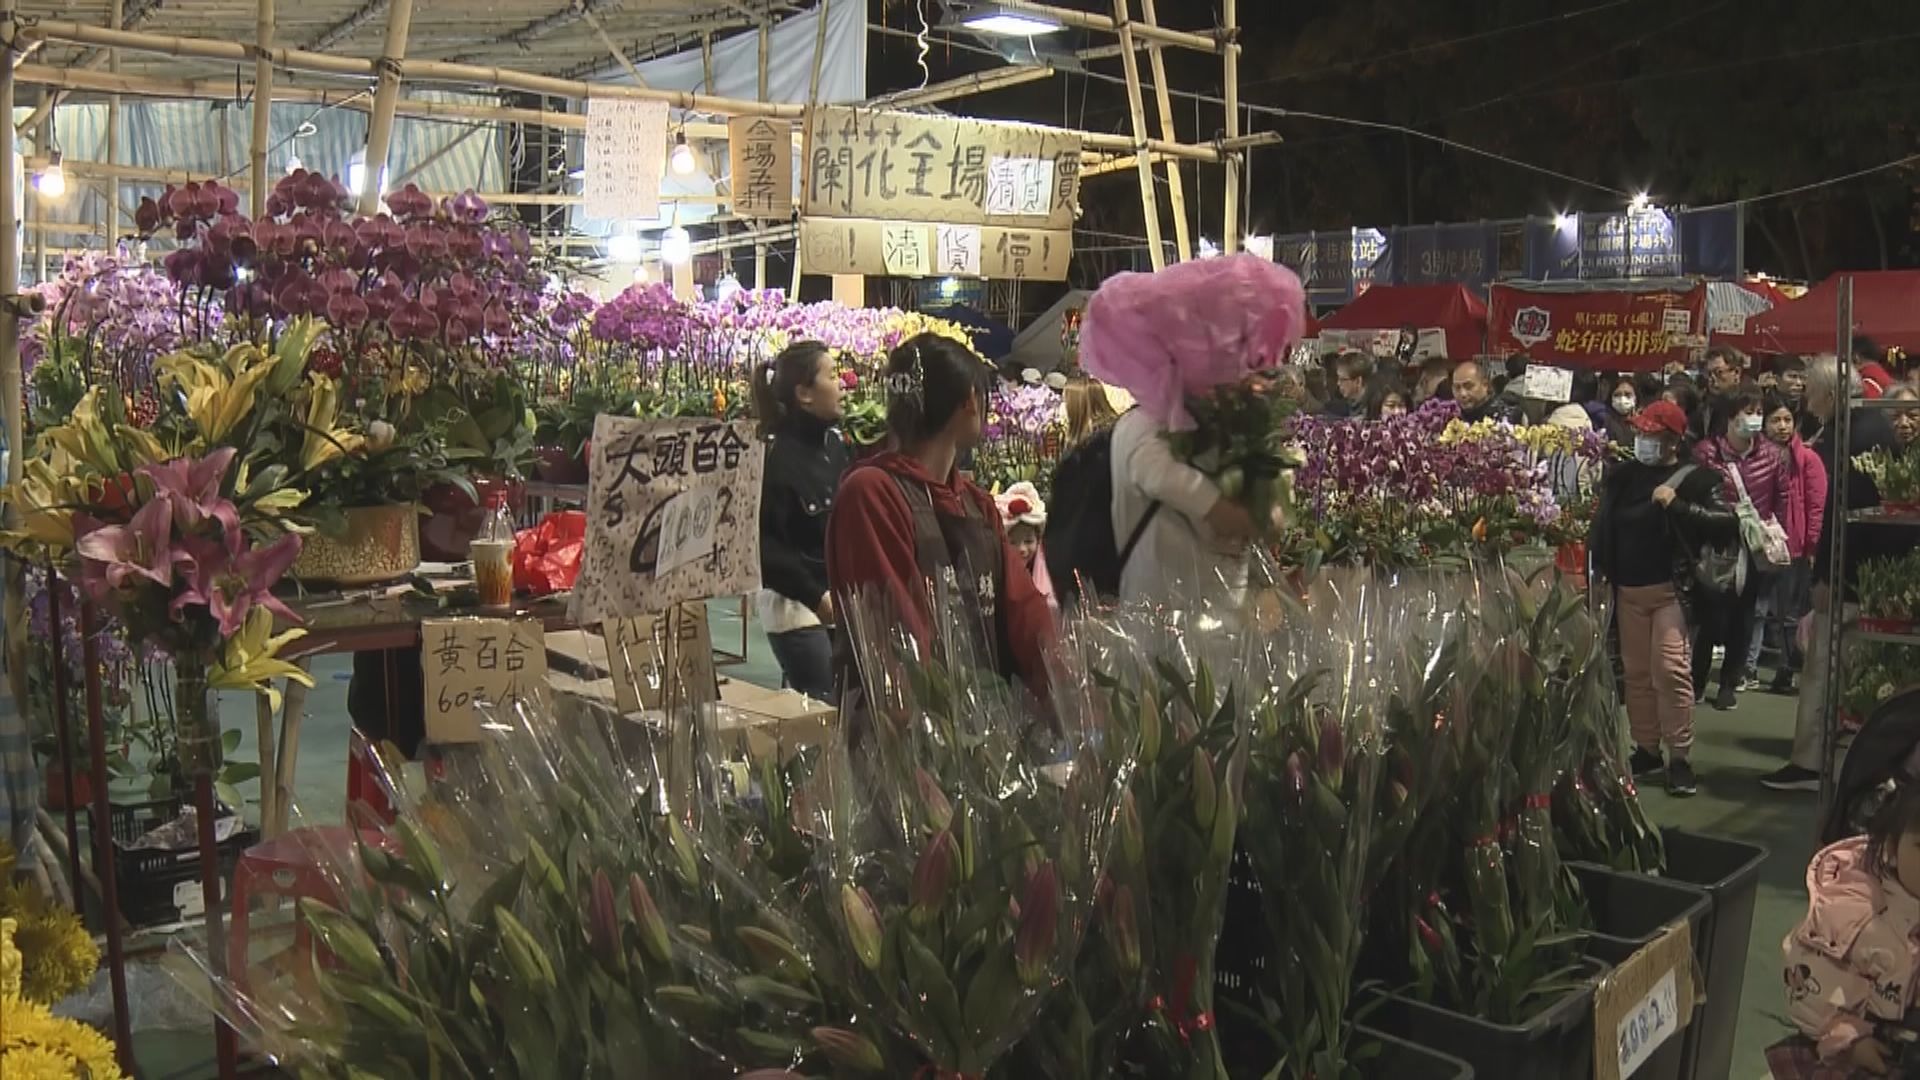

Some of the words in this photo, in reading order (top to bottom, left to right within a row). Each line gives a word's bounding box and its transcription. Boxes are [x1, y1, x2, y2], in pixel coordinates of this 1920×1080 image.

[739, 119, 777, 212] 全場五折
[605, 425, 750, 492] 大頭百合
